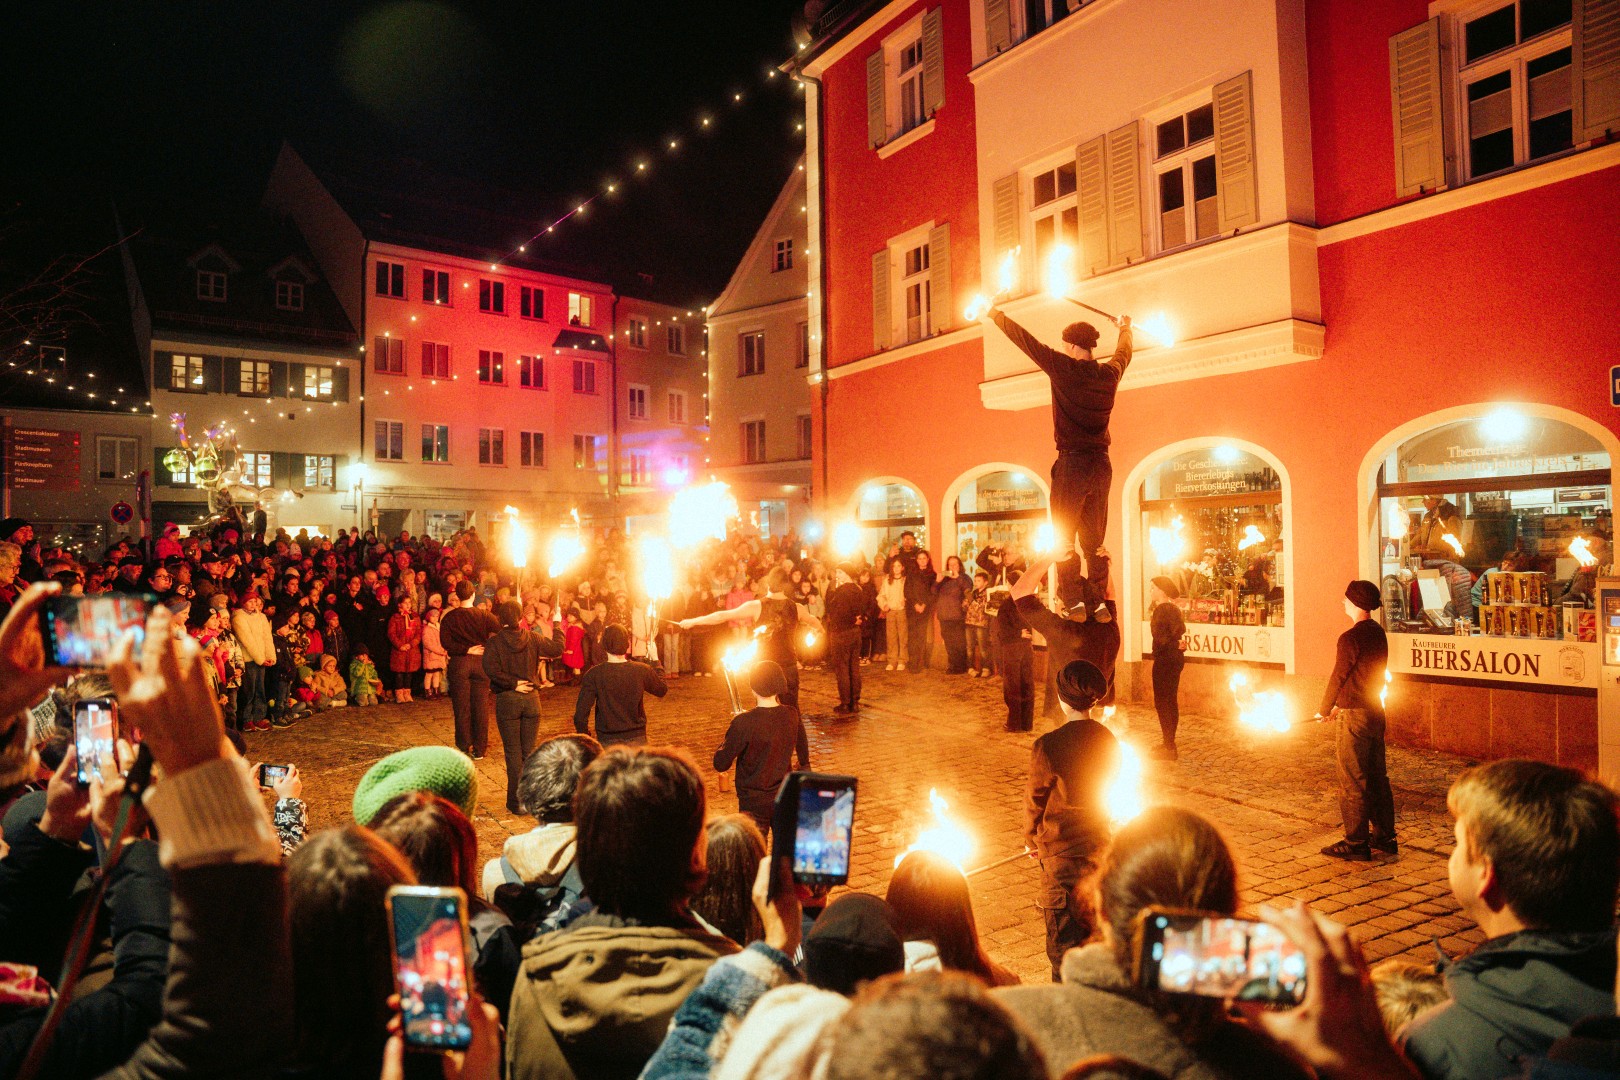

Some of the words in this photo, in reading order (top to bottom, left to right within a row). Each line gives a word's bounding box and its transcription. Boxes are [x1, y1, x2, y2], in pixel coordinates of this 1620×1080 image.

[1173, 461, 1187, 471] Die
[1417, 463, 1439, 475] Das
[1175, 480, 1247, 492] Bierverkostungen
[1184, 634, 1245, 656] RSALON
[1411, 648, 1541, 677] BIERSALON
